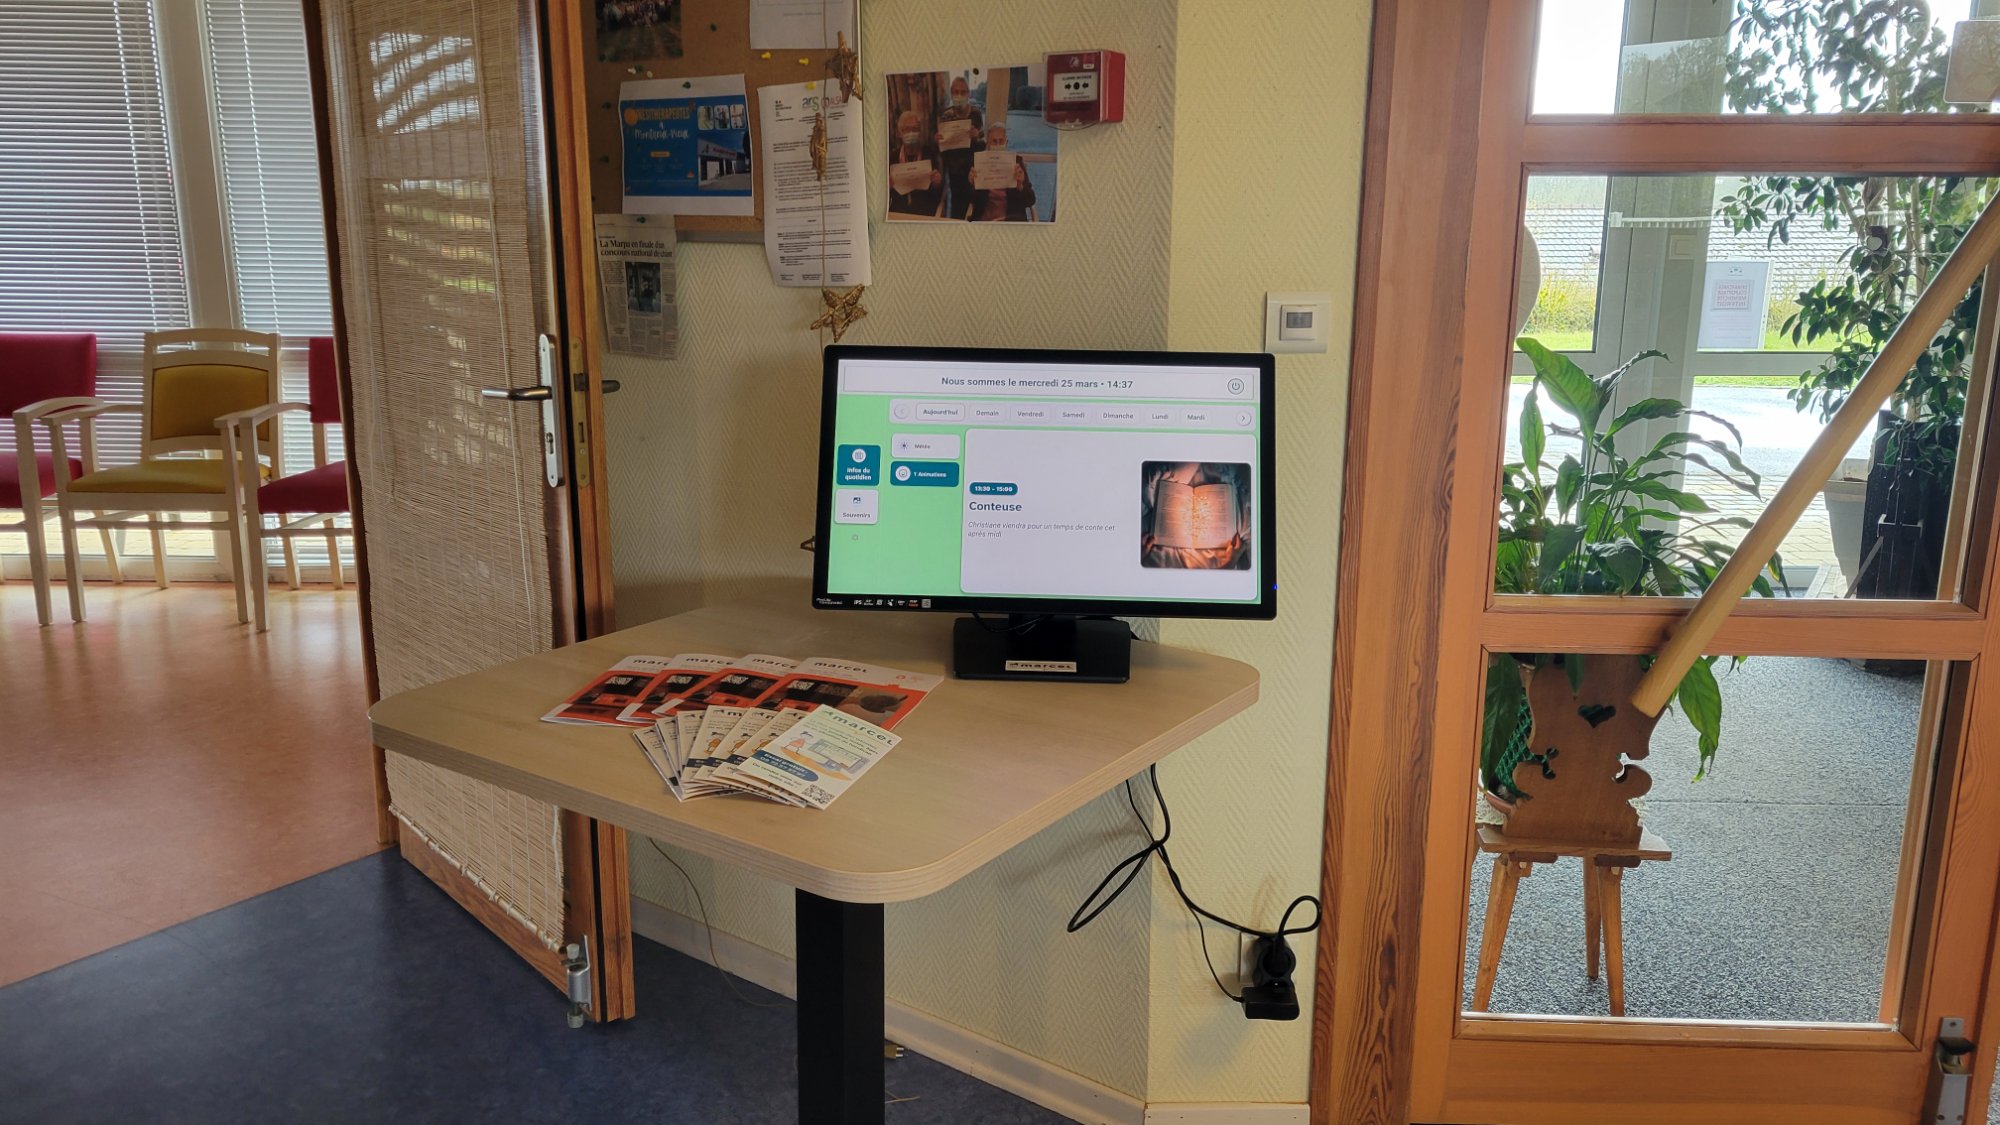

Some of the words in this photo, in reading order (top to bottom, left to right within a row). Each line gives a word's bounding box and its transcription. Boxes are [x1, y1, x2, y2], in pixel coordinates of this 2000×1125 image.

[599, 240, 608, 248] La
[941, 377, 965, 386] Nous
[967, 379, 1006, 387] sommes
[1008, 377, 1017, 387] le
[1019, 378, 1059, 388] mercredi
[1061, 379, 1073, 388] 25
[1107, 380, 1134, 389] 14:37
[923, 408, 959, 416] Aujourd'hui
[1017, 410, 1044, 418] Vendredi
[1062, 411, 1085, 419] Samedi
[1103, 412, 1134, 420] Dimanche
[1151, 413, 1169, 421] Lundi
[1187, 413, 1205, 421] Mardi
[969, 501, 1022, 512] Conteuse
[968, 521, 1001, 529] Christiane
[967, 530, 986, 538] après
